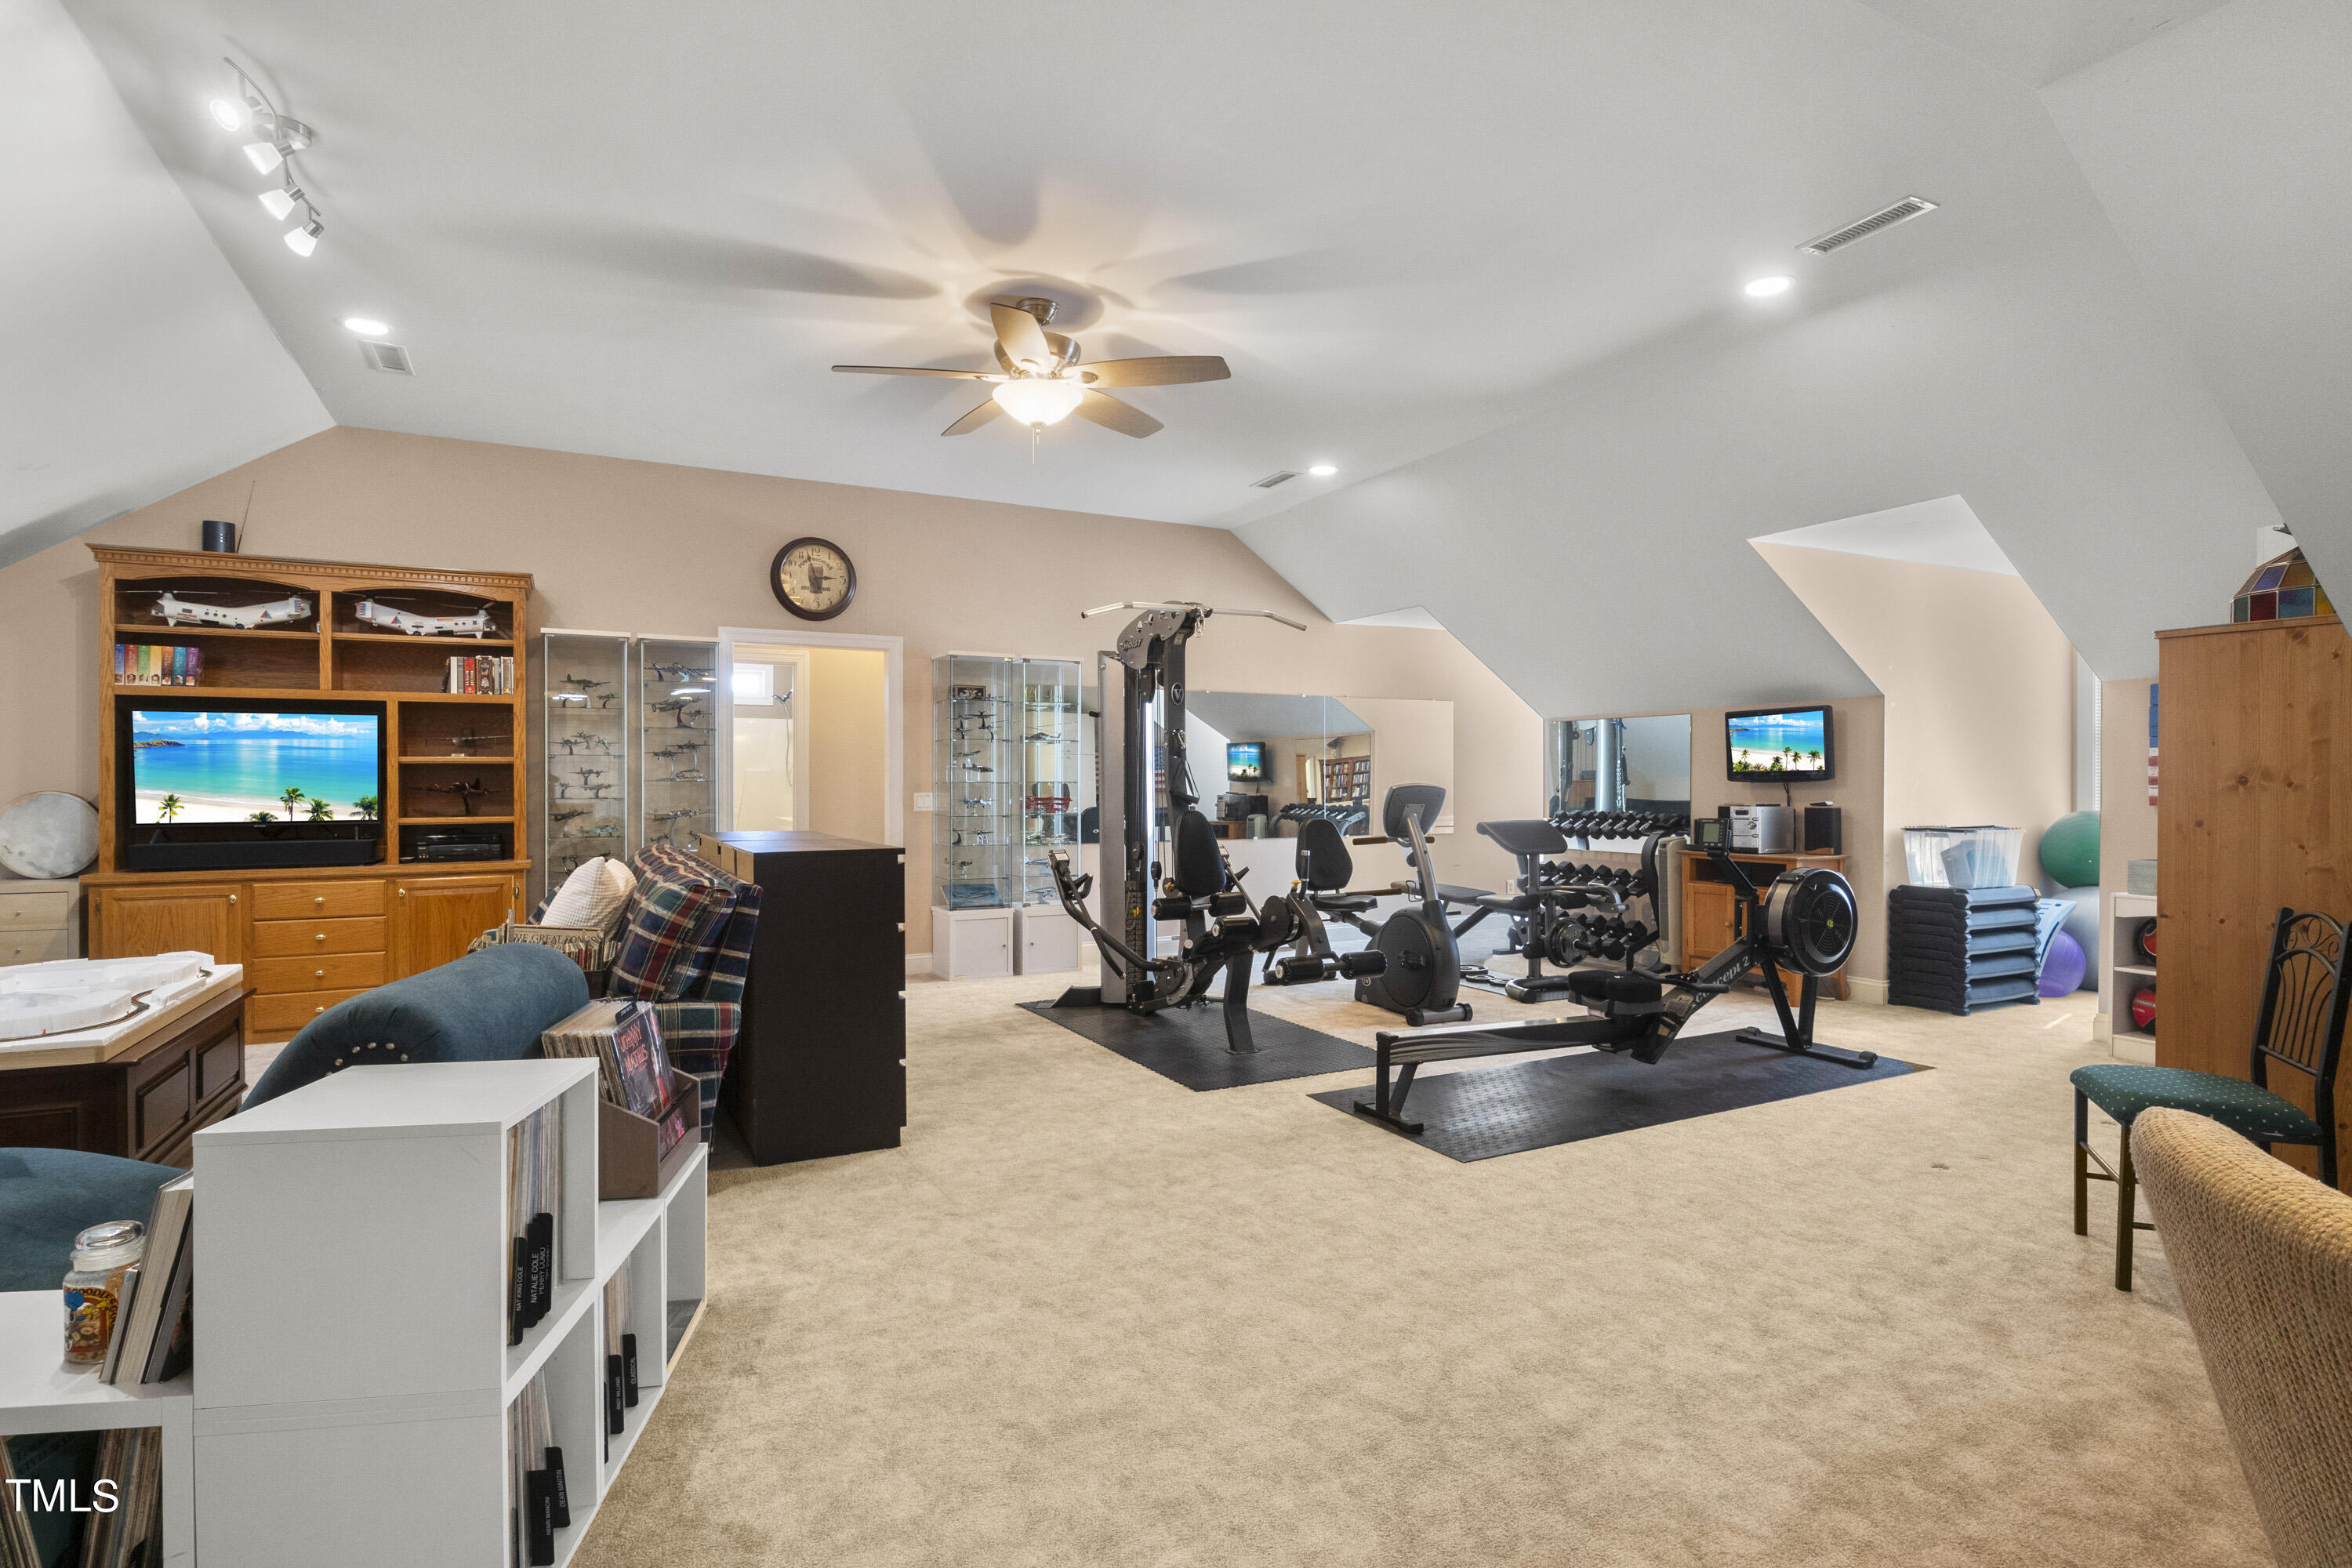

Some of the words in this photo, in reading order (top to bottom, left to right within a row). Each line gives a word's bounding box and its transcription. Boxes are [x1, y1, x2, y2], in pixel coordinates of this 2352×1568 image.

[1123, 638, 1143, 652] HOIST
[1696, 962, 1741, 1003] ccept
[1742, 956, 1751, 967] 2
[620, 1020, 643, 1052] JOHNNY
[624, 1044, 648, 1078] MATHIS
